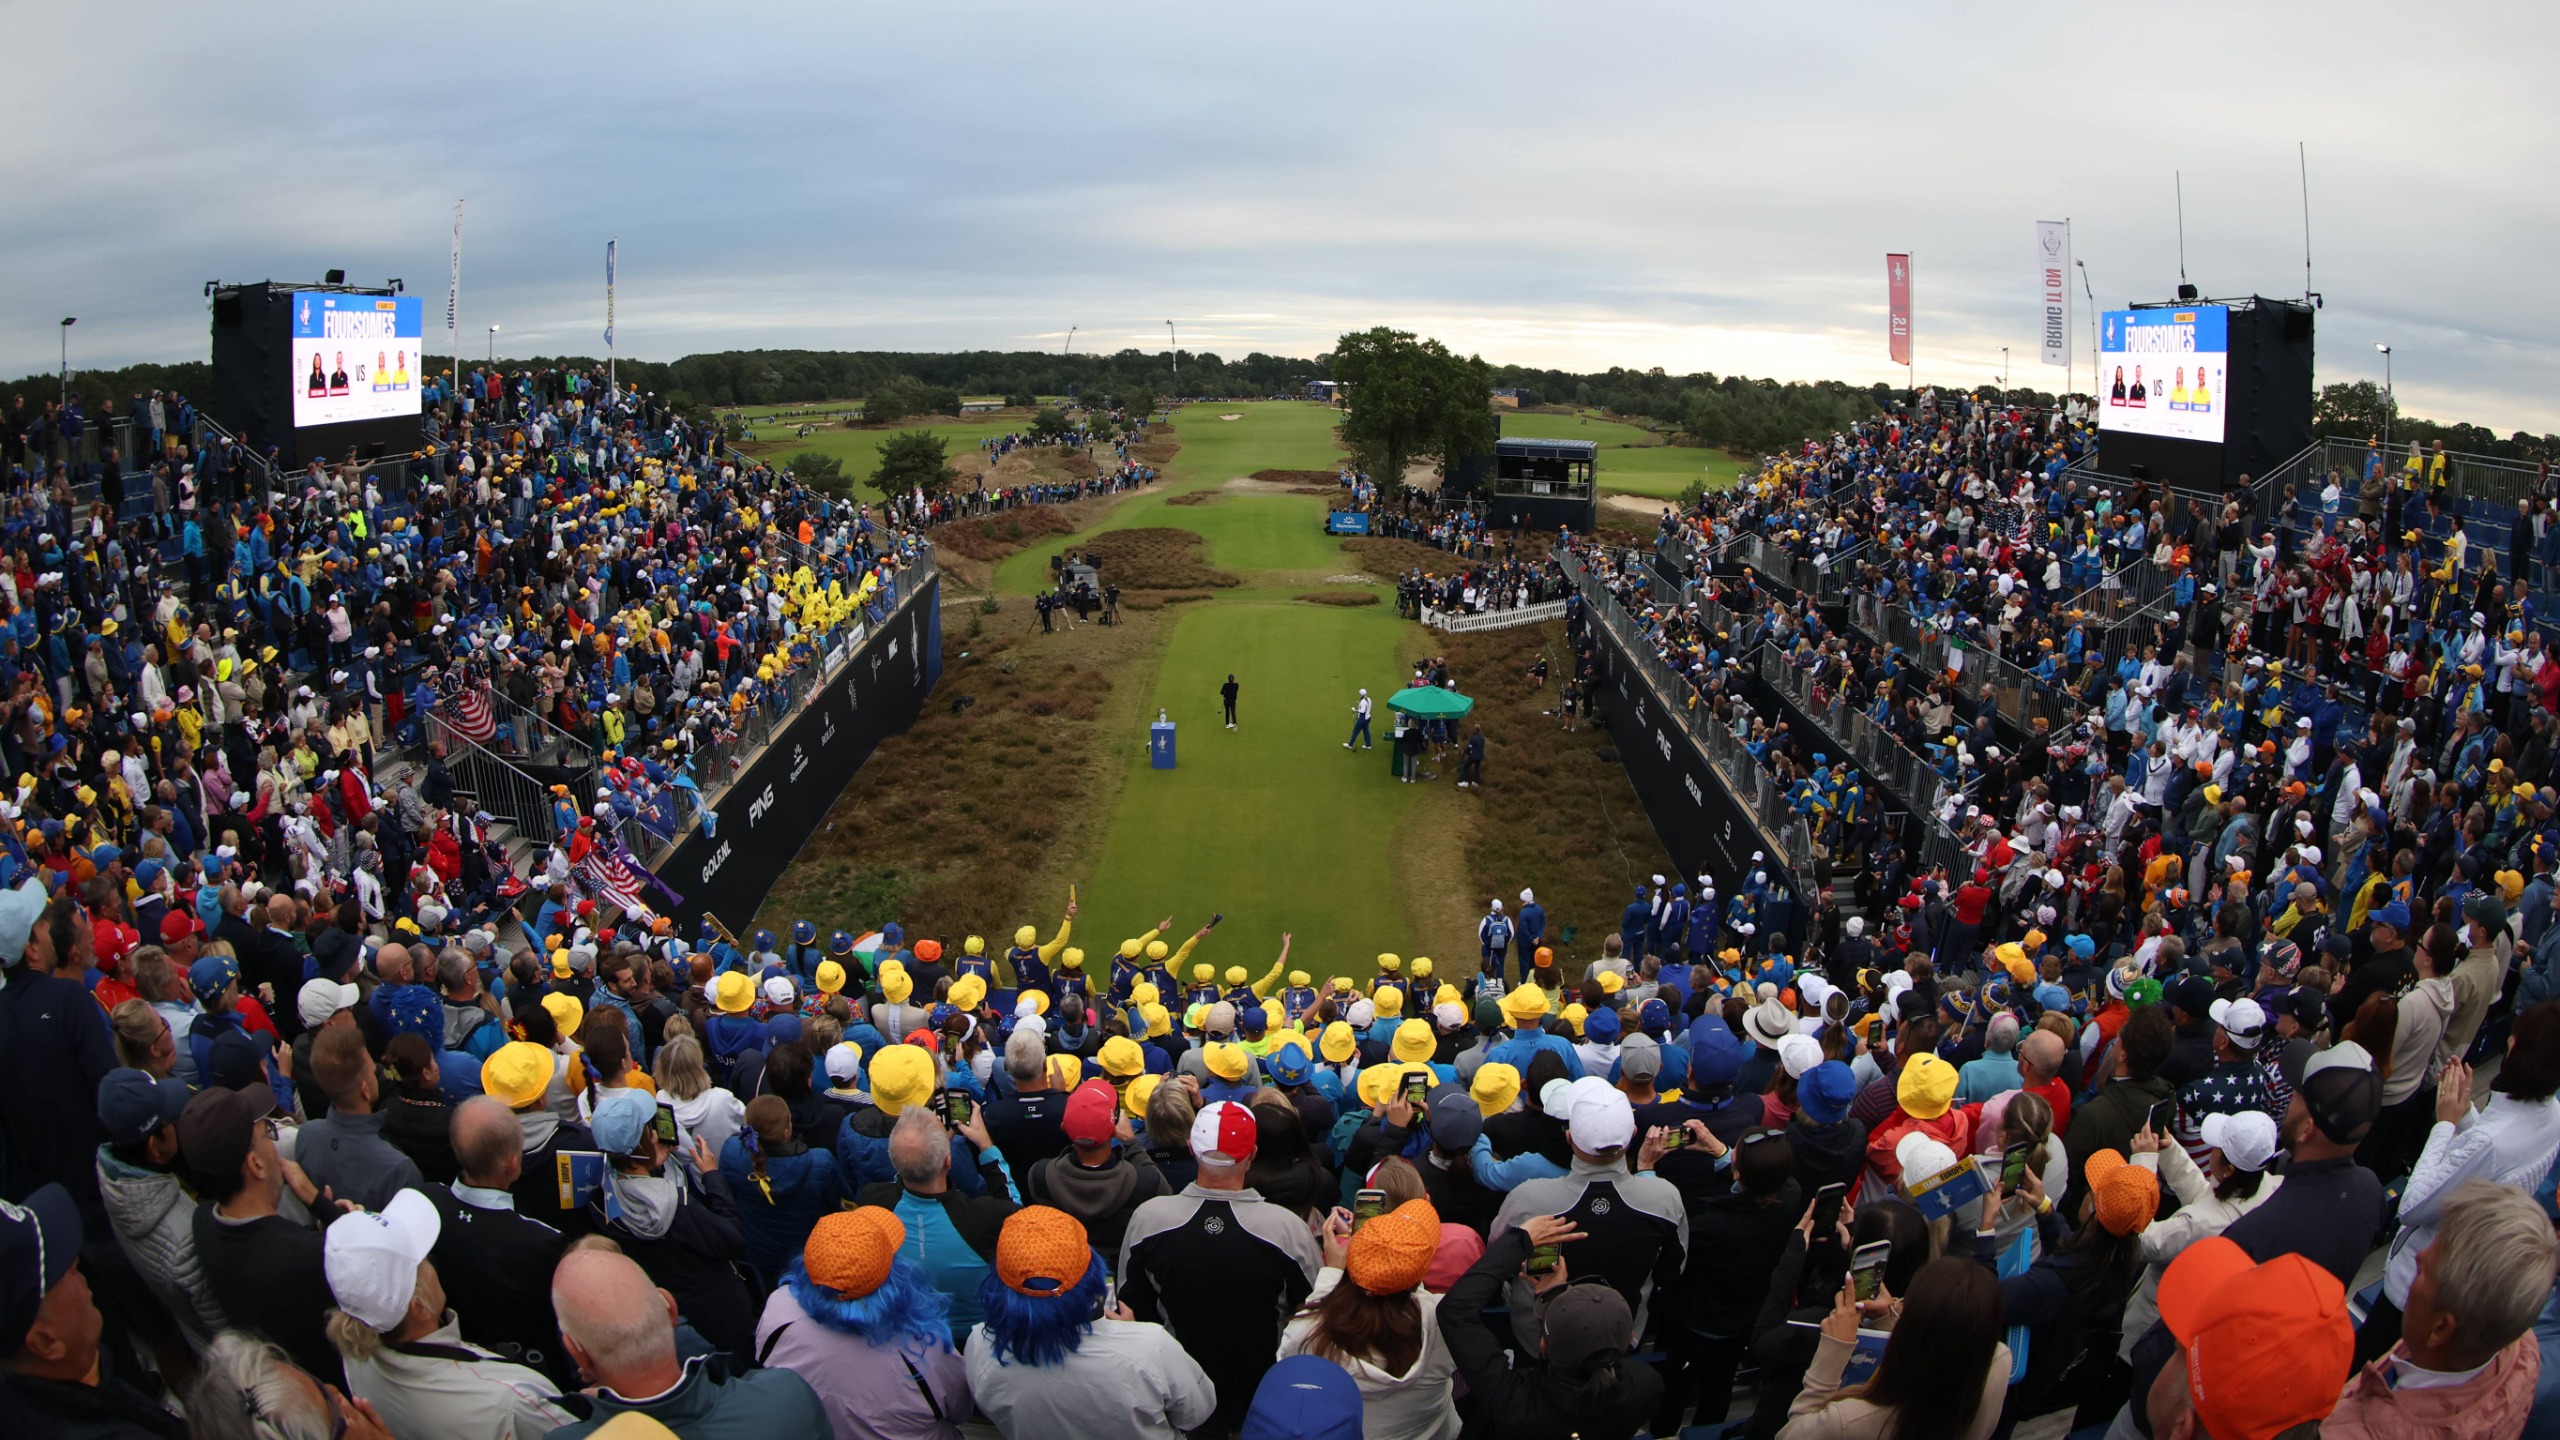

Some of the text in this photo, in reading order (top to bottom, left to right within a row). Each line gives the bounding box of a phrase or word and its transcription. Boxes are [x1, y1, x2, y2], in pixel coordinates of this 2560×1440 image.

[324, 310, 396, 338] FOURSOMES
[2125, 324, 2196, 353] FOURSOMES
[355, 364, 366, 381] VS
[2153, 379, 2163, 397] VS
[1656, 728, 1672, 761] PING
[748, 782, 774, 829] PING
[702, 839, 732, 884] GOLF.NL
[715, 1053, 736, 1066] EUR
[560, 1161, 570, 1184] EUROPE
[1922, 1164, 1964, 1191] TEAM EUROPE
